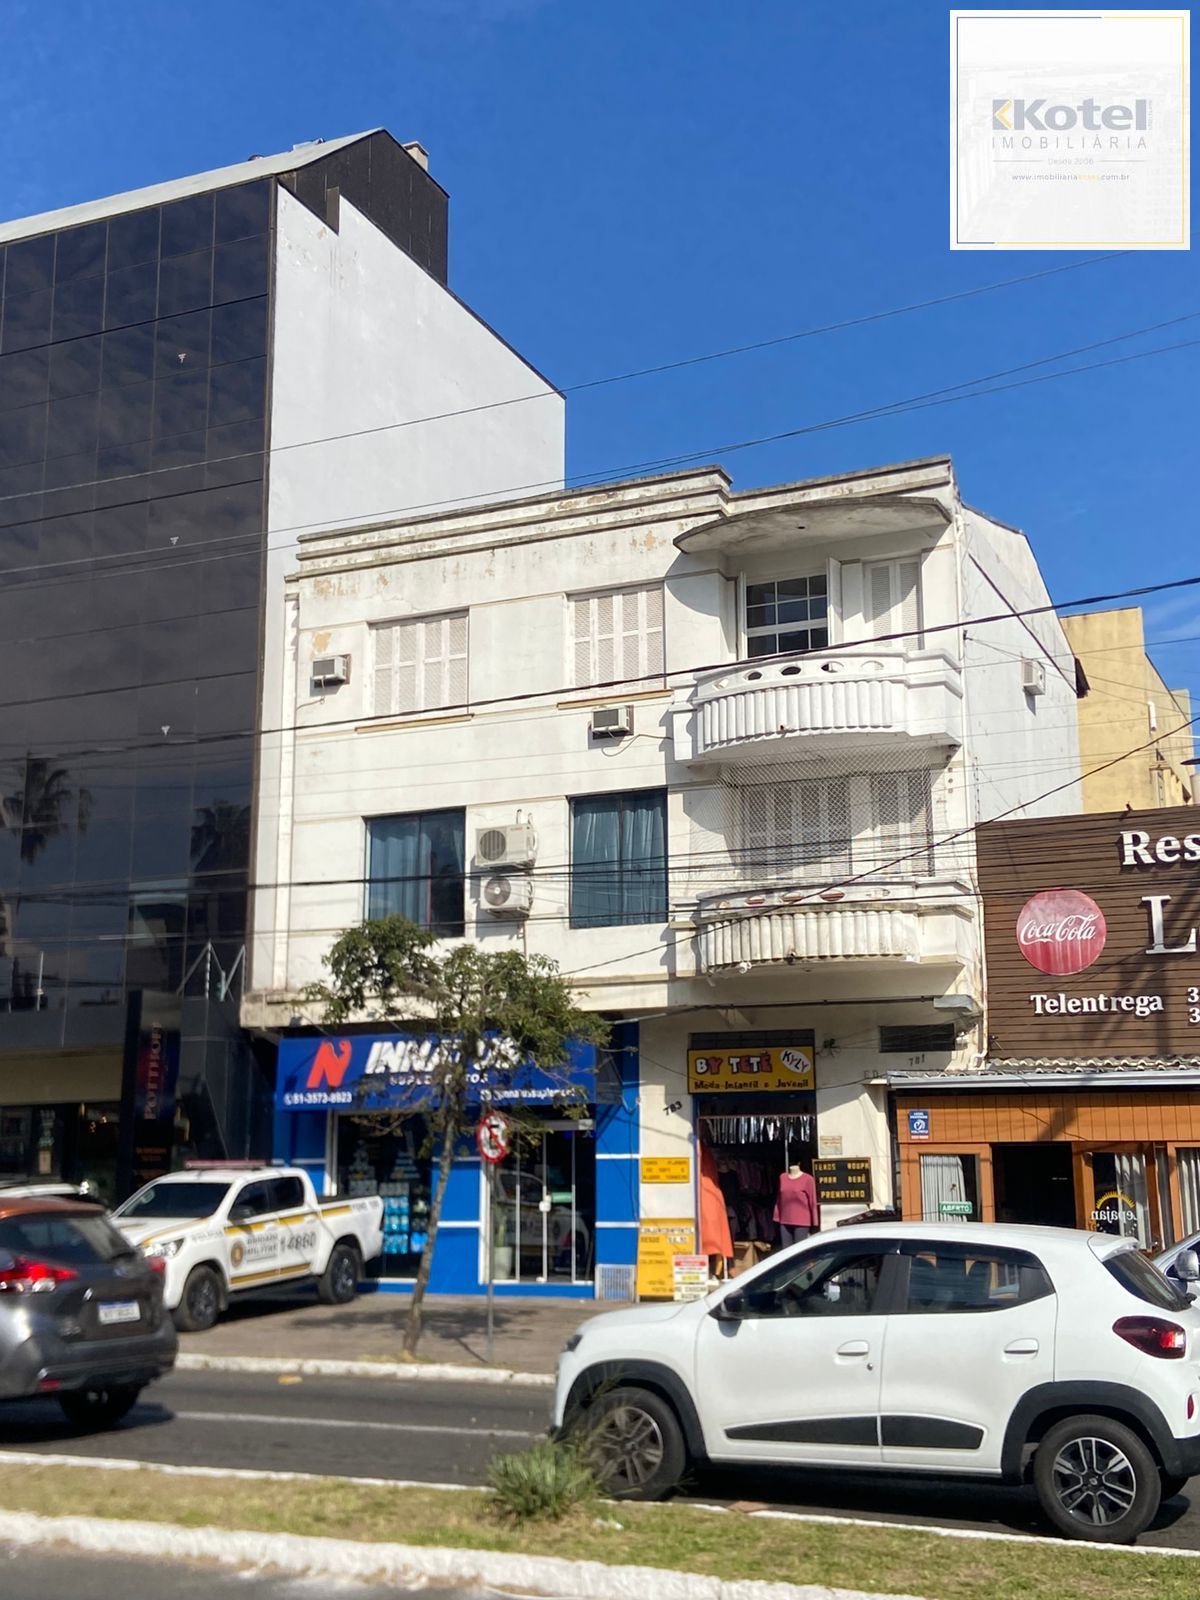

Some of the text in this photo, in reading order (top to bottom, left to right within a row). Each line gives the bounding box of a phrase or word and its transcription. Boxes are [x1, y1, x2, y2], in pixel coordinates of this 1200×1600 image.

[1030, 993, 1164, 1016] Telentrega
[695, 1055, 723, 1075] BY
[781, 1050, 809, 1073] KYLY
[775, 1078, 809, 1088] Juvenil
